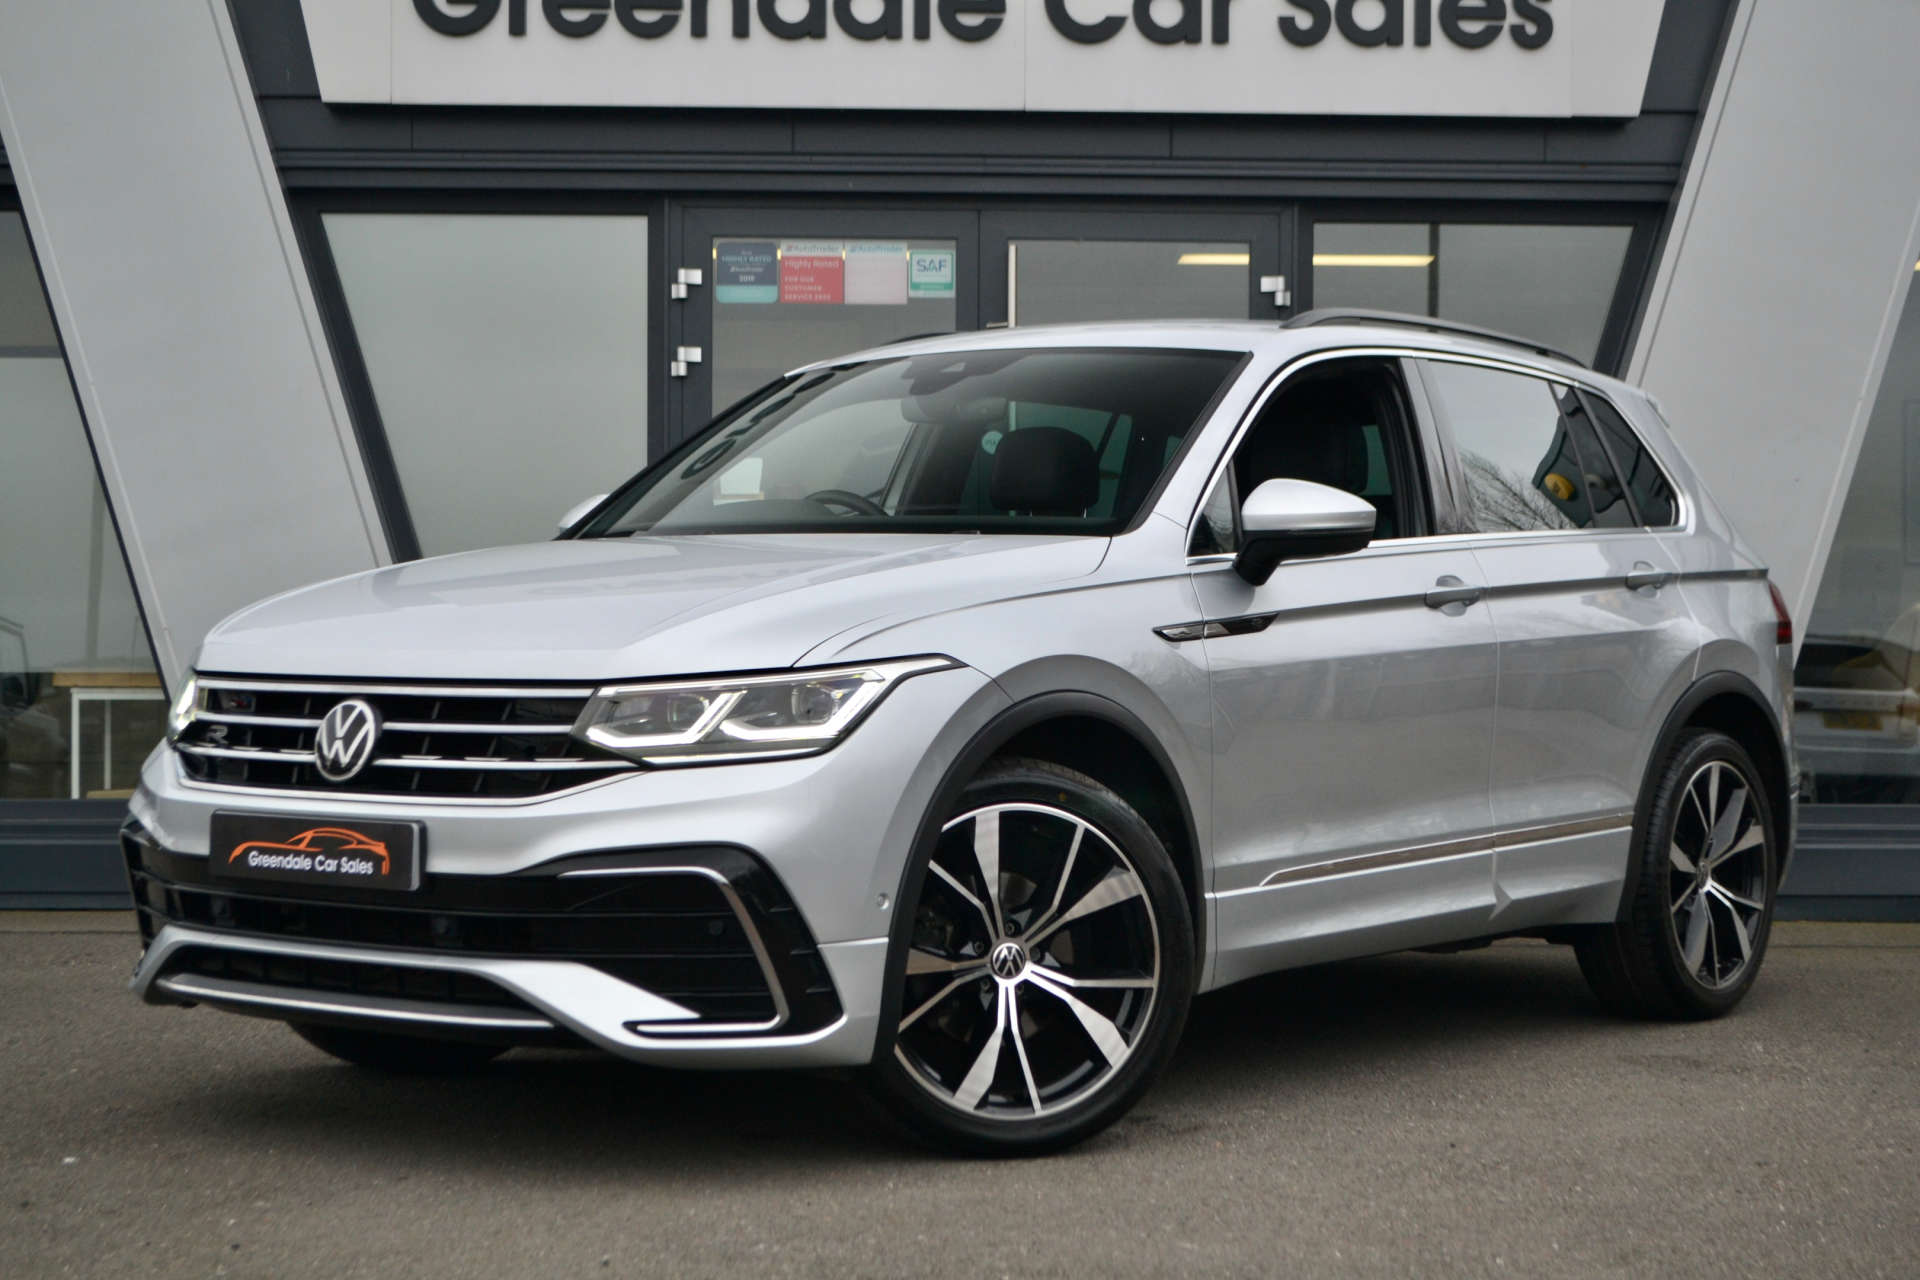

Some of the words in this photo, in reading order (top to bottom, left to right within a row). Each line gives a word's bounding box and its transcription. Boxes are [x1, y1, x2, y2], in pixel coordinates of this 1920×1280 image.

[784, 258, 811, 271] Highly
[915, 258, 947, 272] SAF
[205, 724, 229, 745] R
[247, 850, 312, 870] Greendale
[314, 854, 338, 872] Car
[340, 856, 374, 875] Sales
